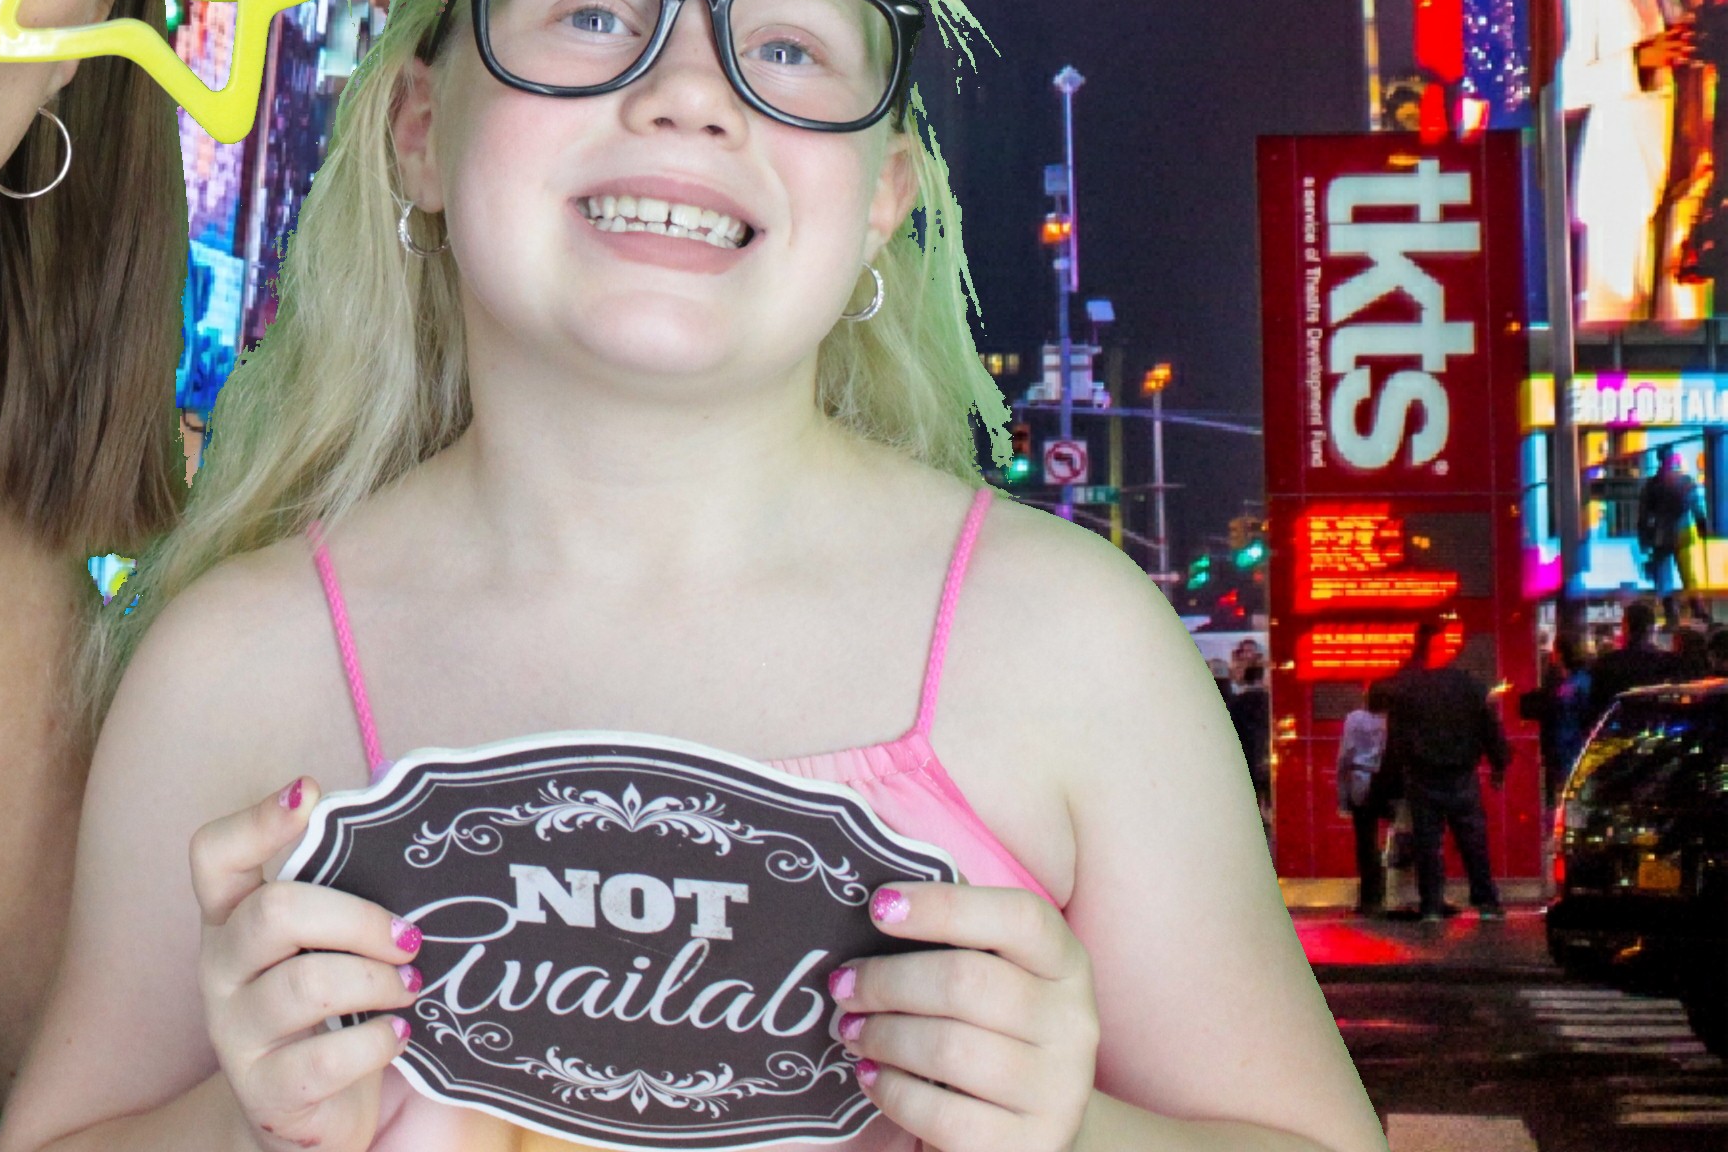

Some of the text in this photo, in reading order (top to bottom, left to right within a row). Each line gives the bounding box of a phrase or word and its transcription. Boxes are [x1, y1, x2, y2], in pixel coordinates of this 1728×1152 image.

[1303, 189, 1320, 243] service
[1305, 266, 1322, 324] Theatre
[1327, 159, 1480, 474] tkts
[1304, 328, 1324, 426] Development
[1310, 430, 1327, 469] Fund
[508, 862, 750, 941] NOT
[403, 894, 844, 1038] Availab
